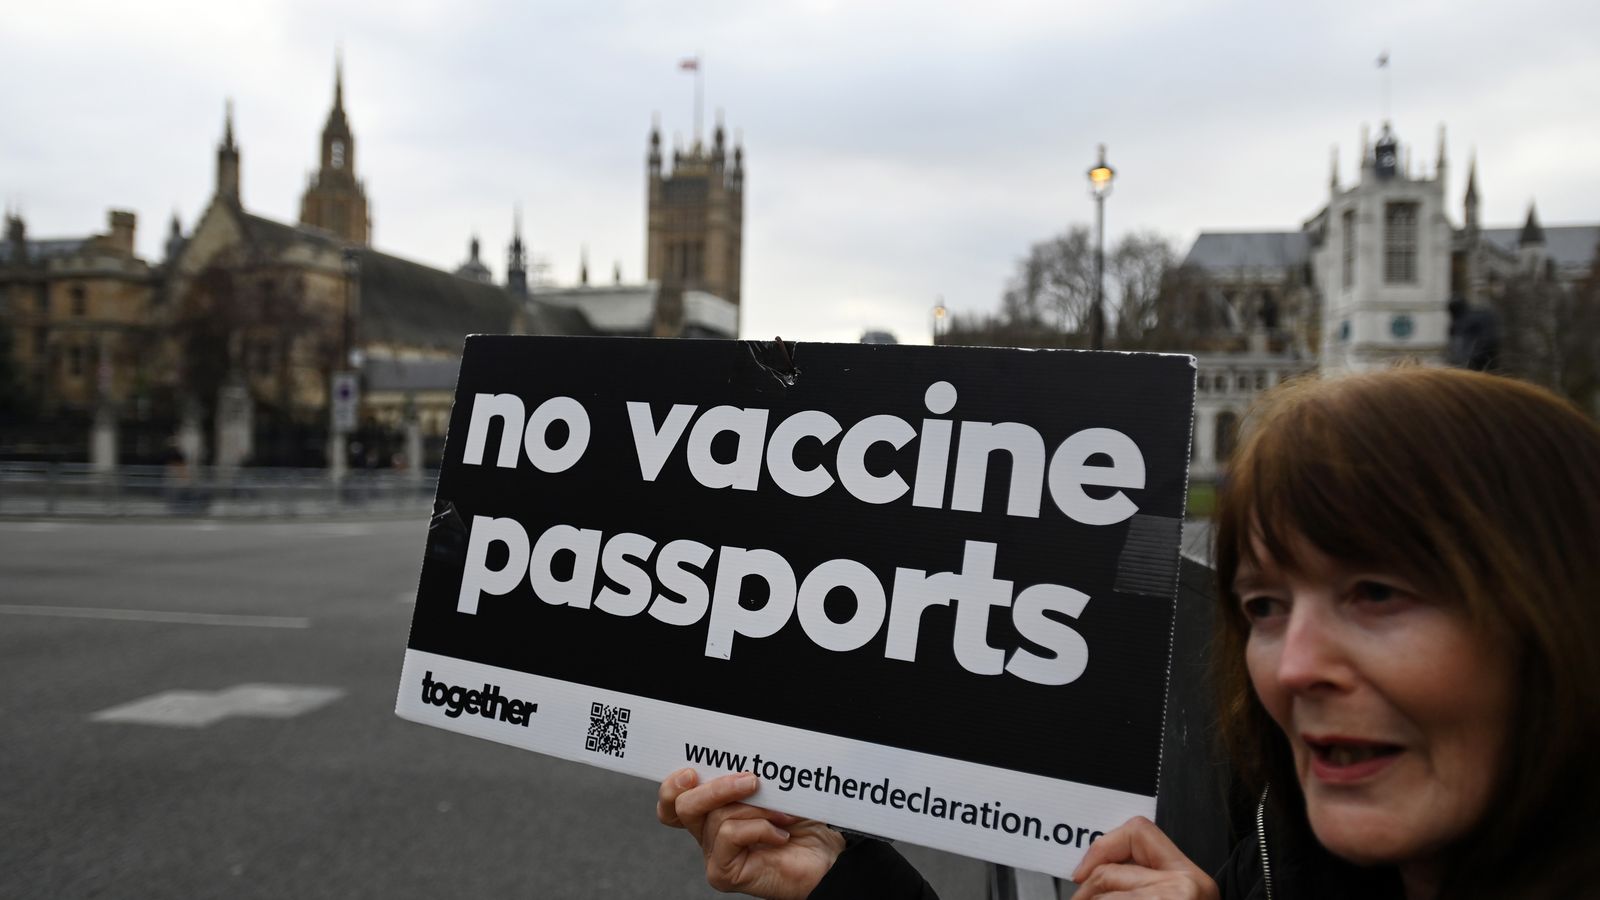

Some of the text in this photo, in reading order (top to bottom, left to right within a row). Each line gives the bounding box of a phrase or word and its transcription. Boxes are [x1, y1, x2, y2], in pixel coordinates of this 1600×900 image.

[463, 381, 1145, 525] no vaccine
[457, 515, 1090, 685] passports
[421, 671, 538, 728] together
